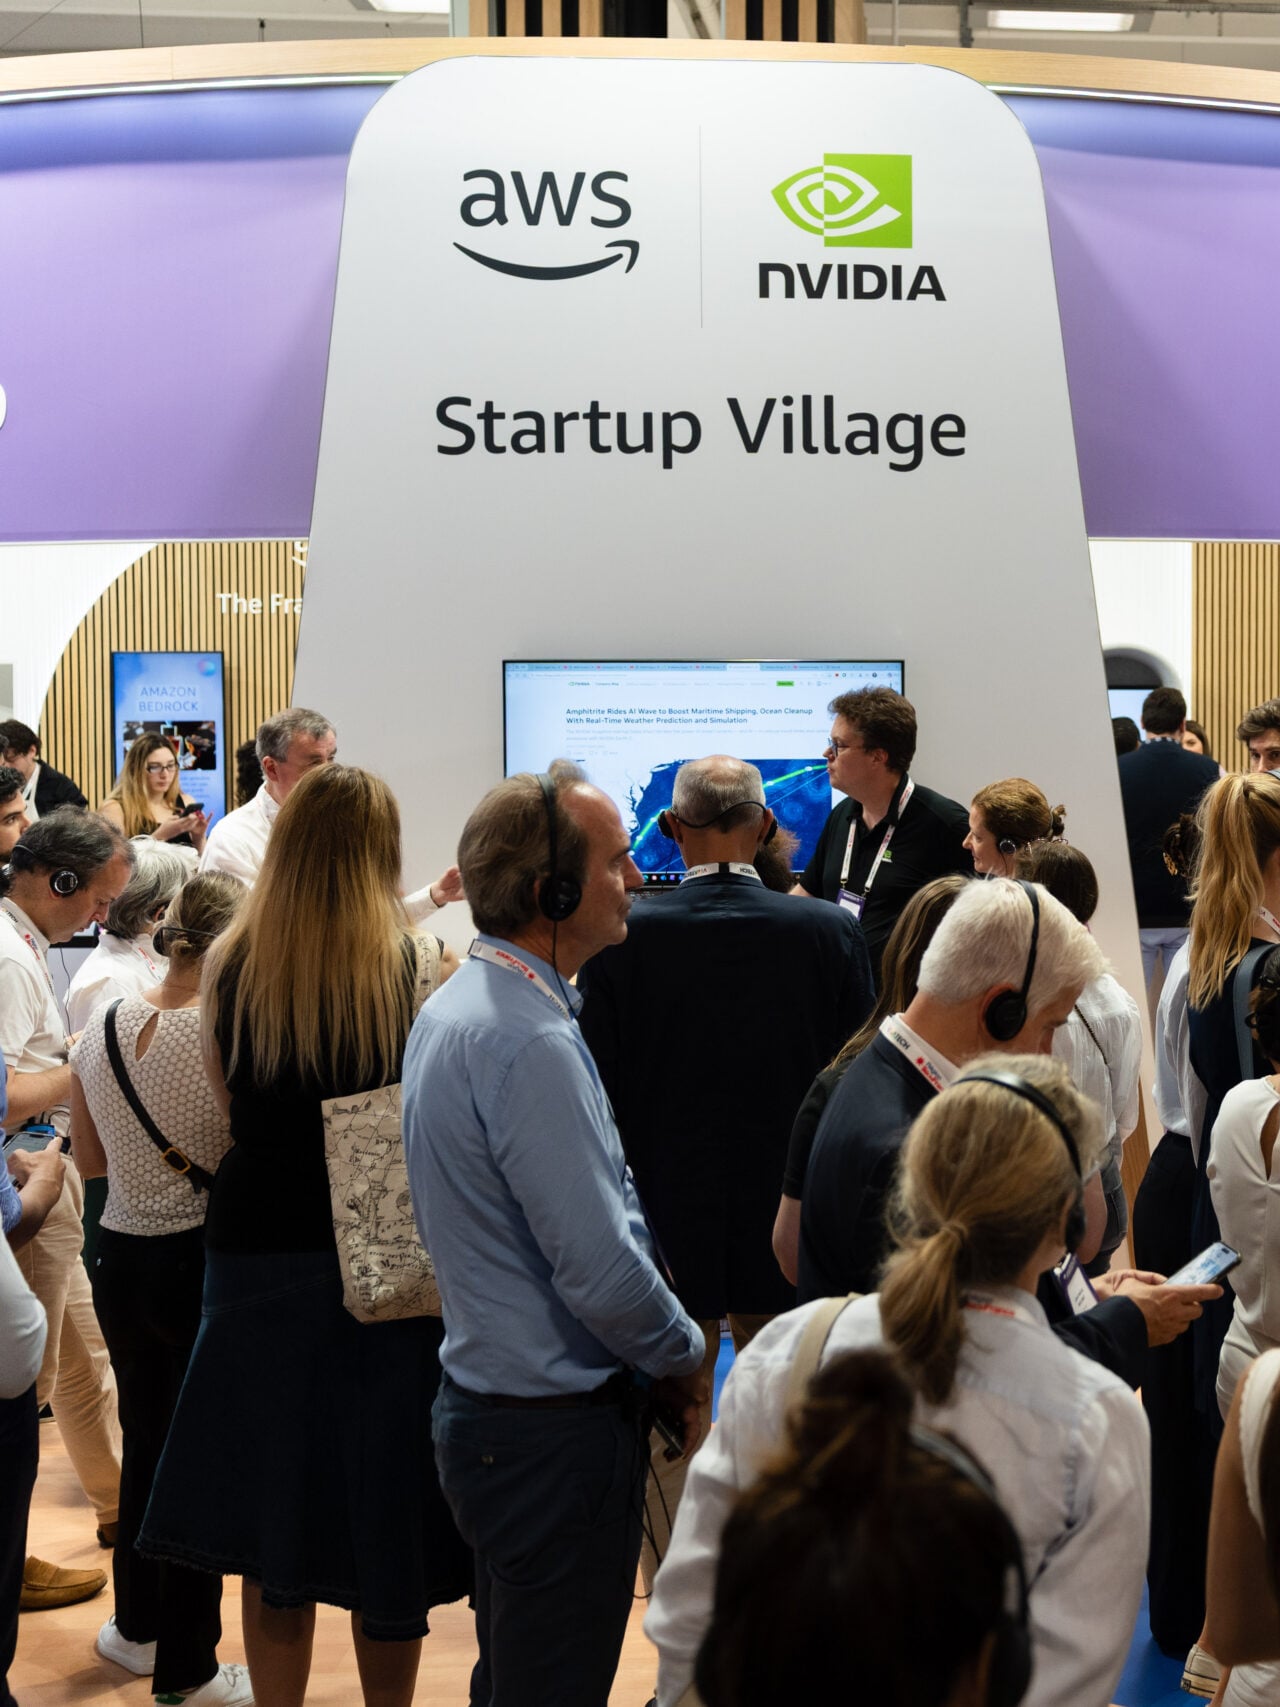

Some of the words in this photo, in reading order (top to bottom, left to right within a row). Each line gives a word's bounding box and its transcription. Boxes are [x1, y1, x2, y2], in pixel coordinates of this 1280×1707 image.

[460, 169, 632, 229] aws
[436, 396, 702, 470] Startup
[727, 394, 966, 473] Village
[216, 592, 264, 614] The
[140, 685, 197, 698] AMAZON
[138, 700, 199, 712] BEDROCK
[566, 708, 606, 716] Amphitrite
[668, 707, 689, 715] Boost
[691, 707, 723, 715] Maritime
[760, 707, 782, 715] Ocean
[784, 707, 813, 716] Cleanup
